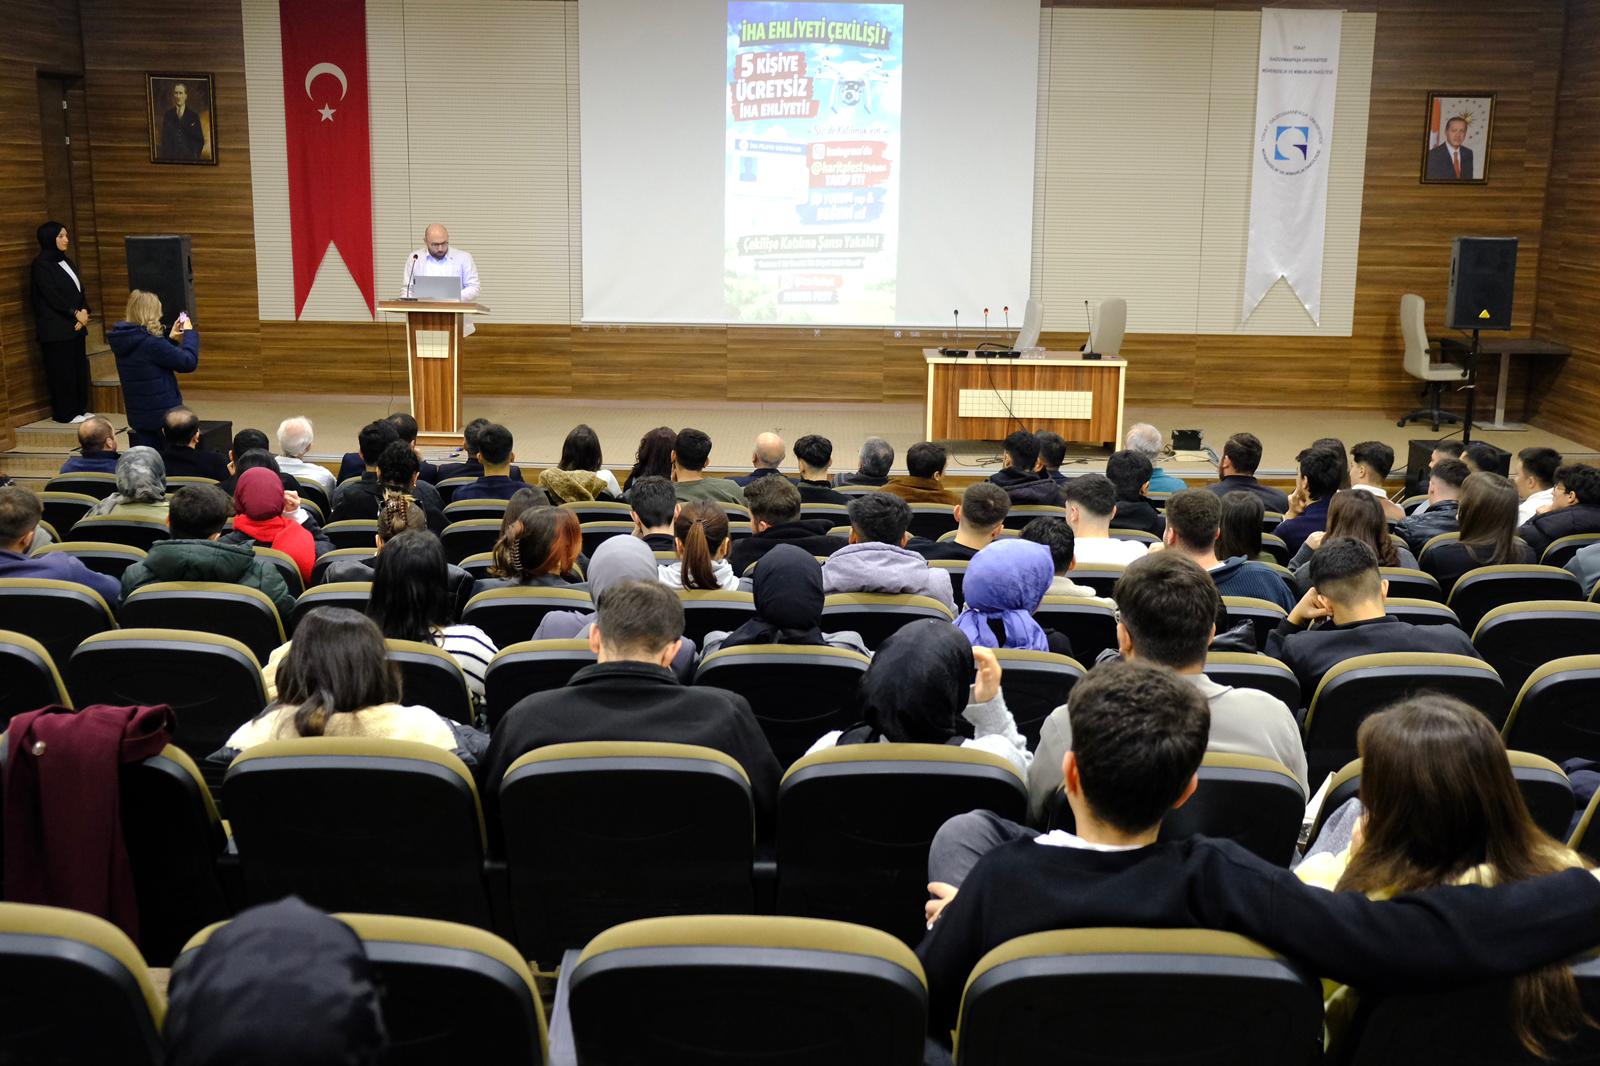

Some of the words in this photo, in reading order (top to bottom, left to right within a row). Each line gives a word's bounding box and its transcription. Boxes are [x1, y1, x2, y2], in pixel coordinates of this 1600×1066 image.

[742, 20, 765, 42] İHA
[769, 18, 825, 39] EHLİYETİ
[741, 54, 753, 77] 5
[756, 52, 799, 77] KİŞİYE
[736, 75, 808, 100] ÜCRETSİZ
[739, 102, 759, 119] İHA
